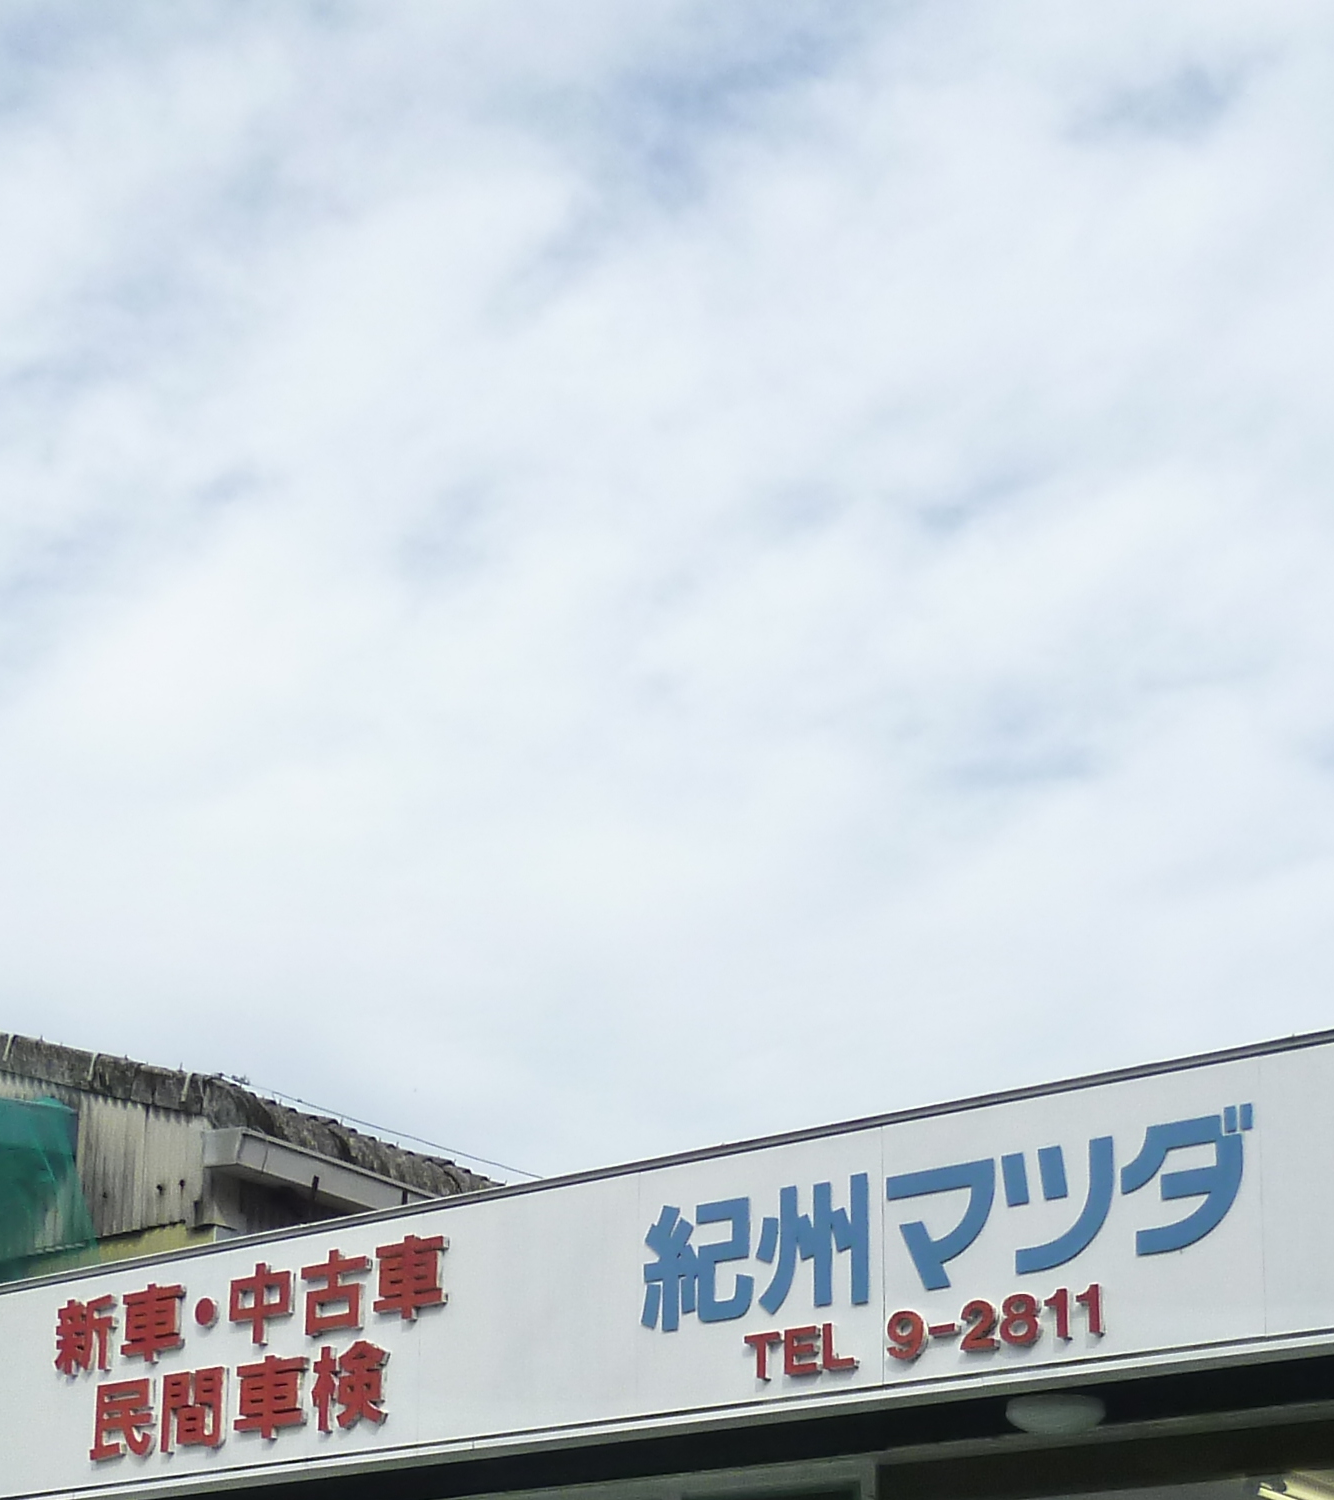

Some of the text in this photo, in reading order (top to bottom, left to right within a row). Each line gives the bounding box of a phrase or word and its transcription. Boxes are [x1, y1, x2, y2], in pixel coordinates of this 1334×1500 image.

[640, 1102, 1255, 1333] 紀州マツダ
[53, 1233, 450, 1376] 新車・中古車
[744, 1282, 1108, 1382] TEL 9-2811
[89, 1339, 391, 1462] 民間車検
